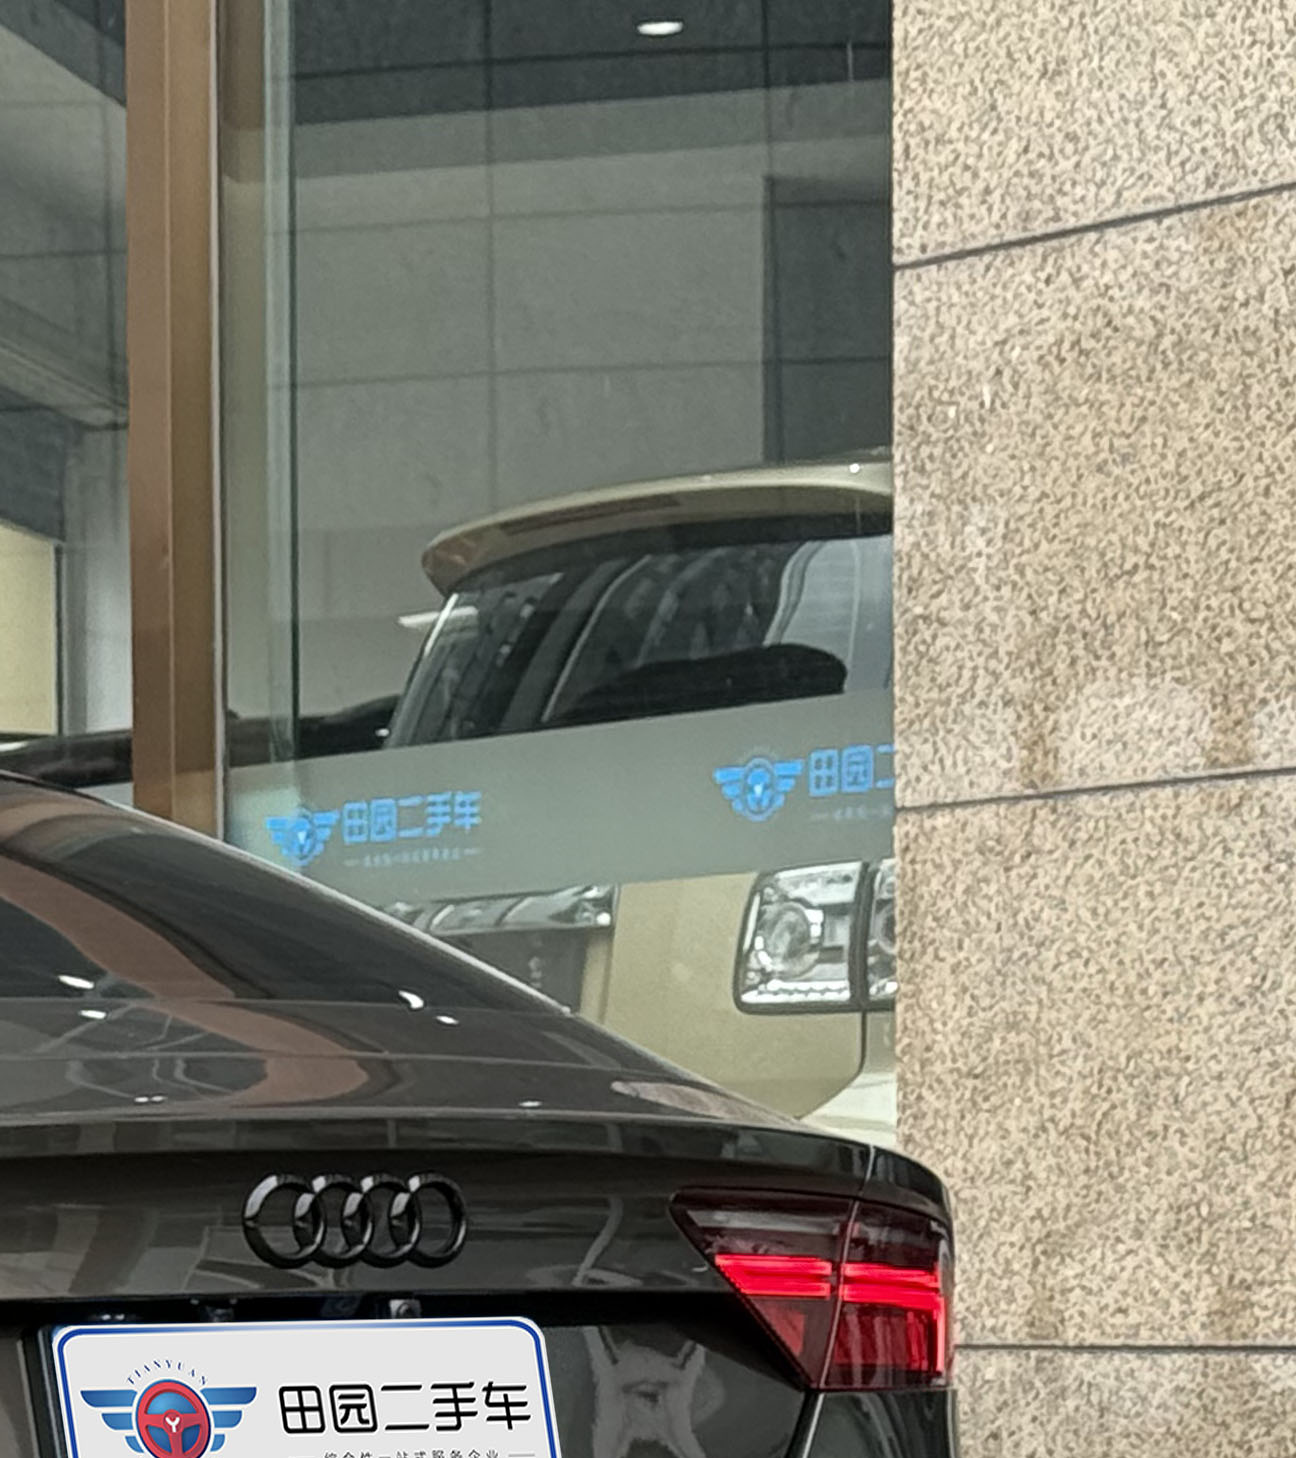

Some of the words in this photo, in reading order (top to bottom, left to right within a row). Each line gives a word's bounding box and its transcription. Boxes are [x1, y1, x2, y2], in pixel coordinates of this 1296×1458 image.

[342, 790, 482, 845] 田园二手车
[279, 1381, 531, 1434] 田园二手车
